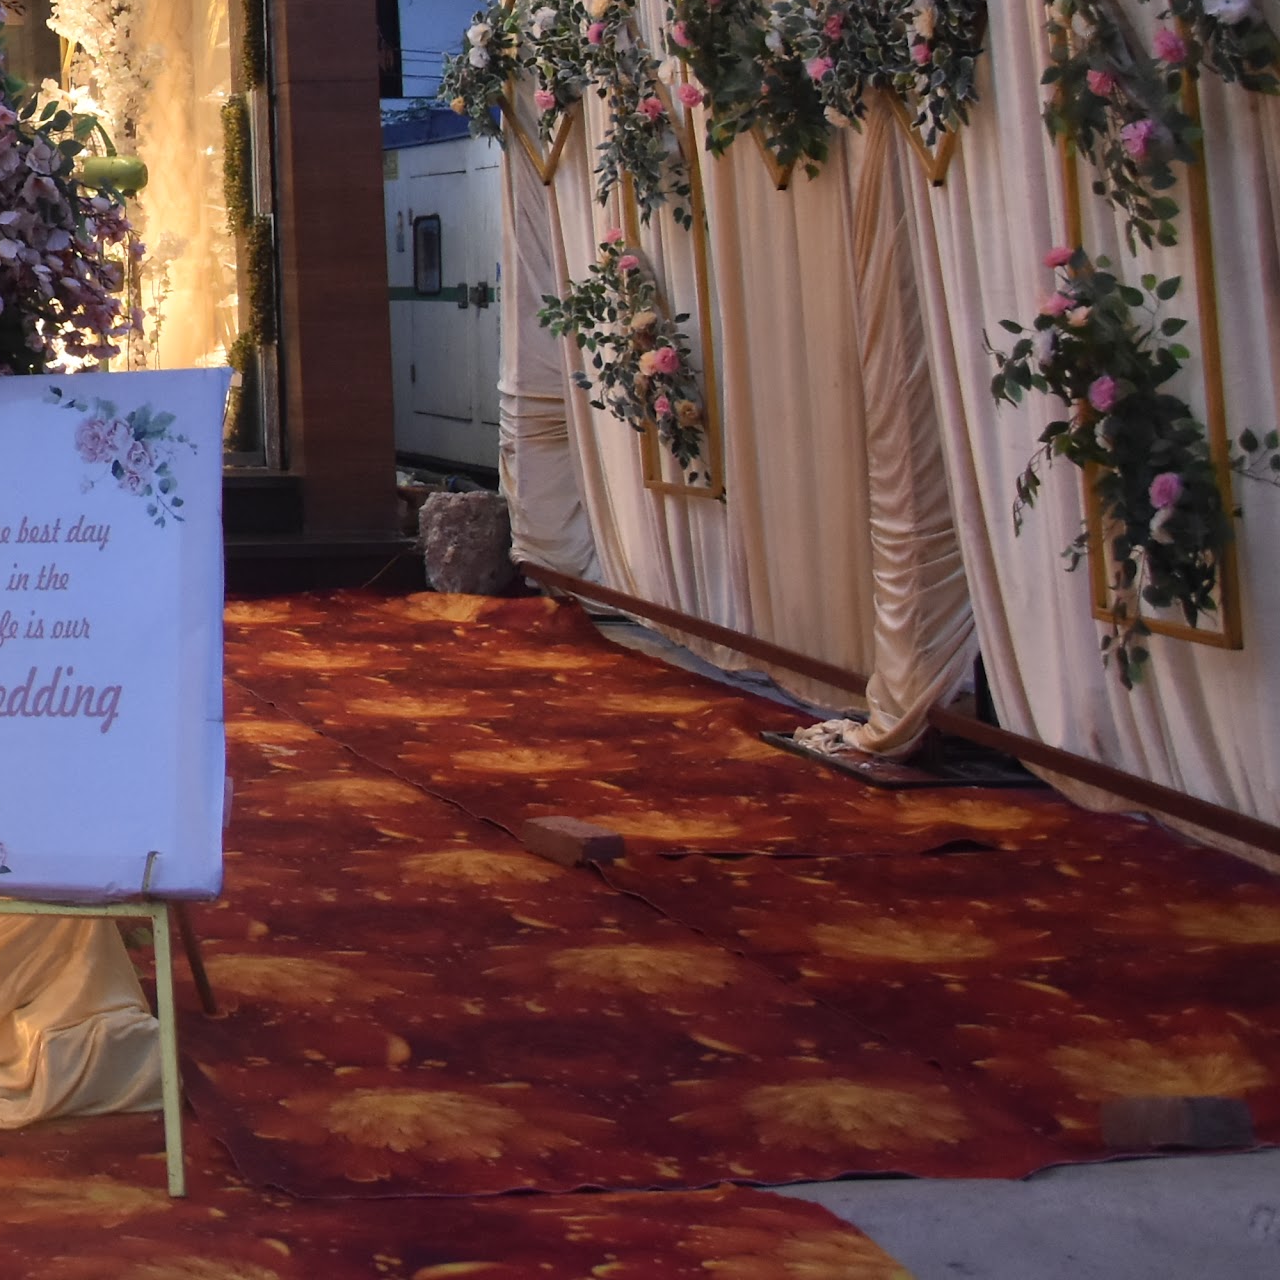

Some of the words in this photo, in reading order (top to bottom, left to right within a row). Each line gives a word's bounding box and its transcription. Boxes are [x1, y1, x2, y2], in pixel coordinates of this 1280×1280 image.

[15, 516, 61, 543] best
[64, 515, 111, 551] day
[5, 563, 29, 591] in
[34, 563, 70, 591] the
[23, 610, 44, 639] is
[50, 617, 90, 640] our
